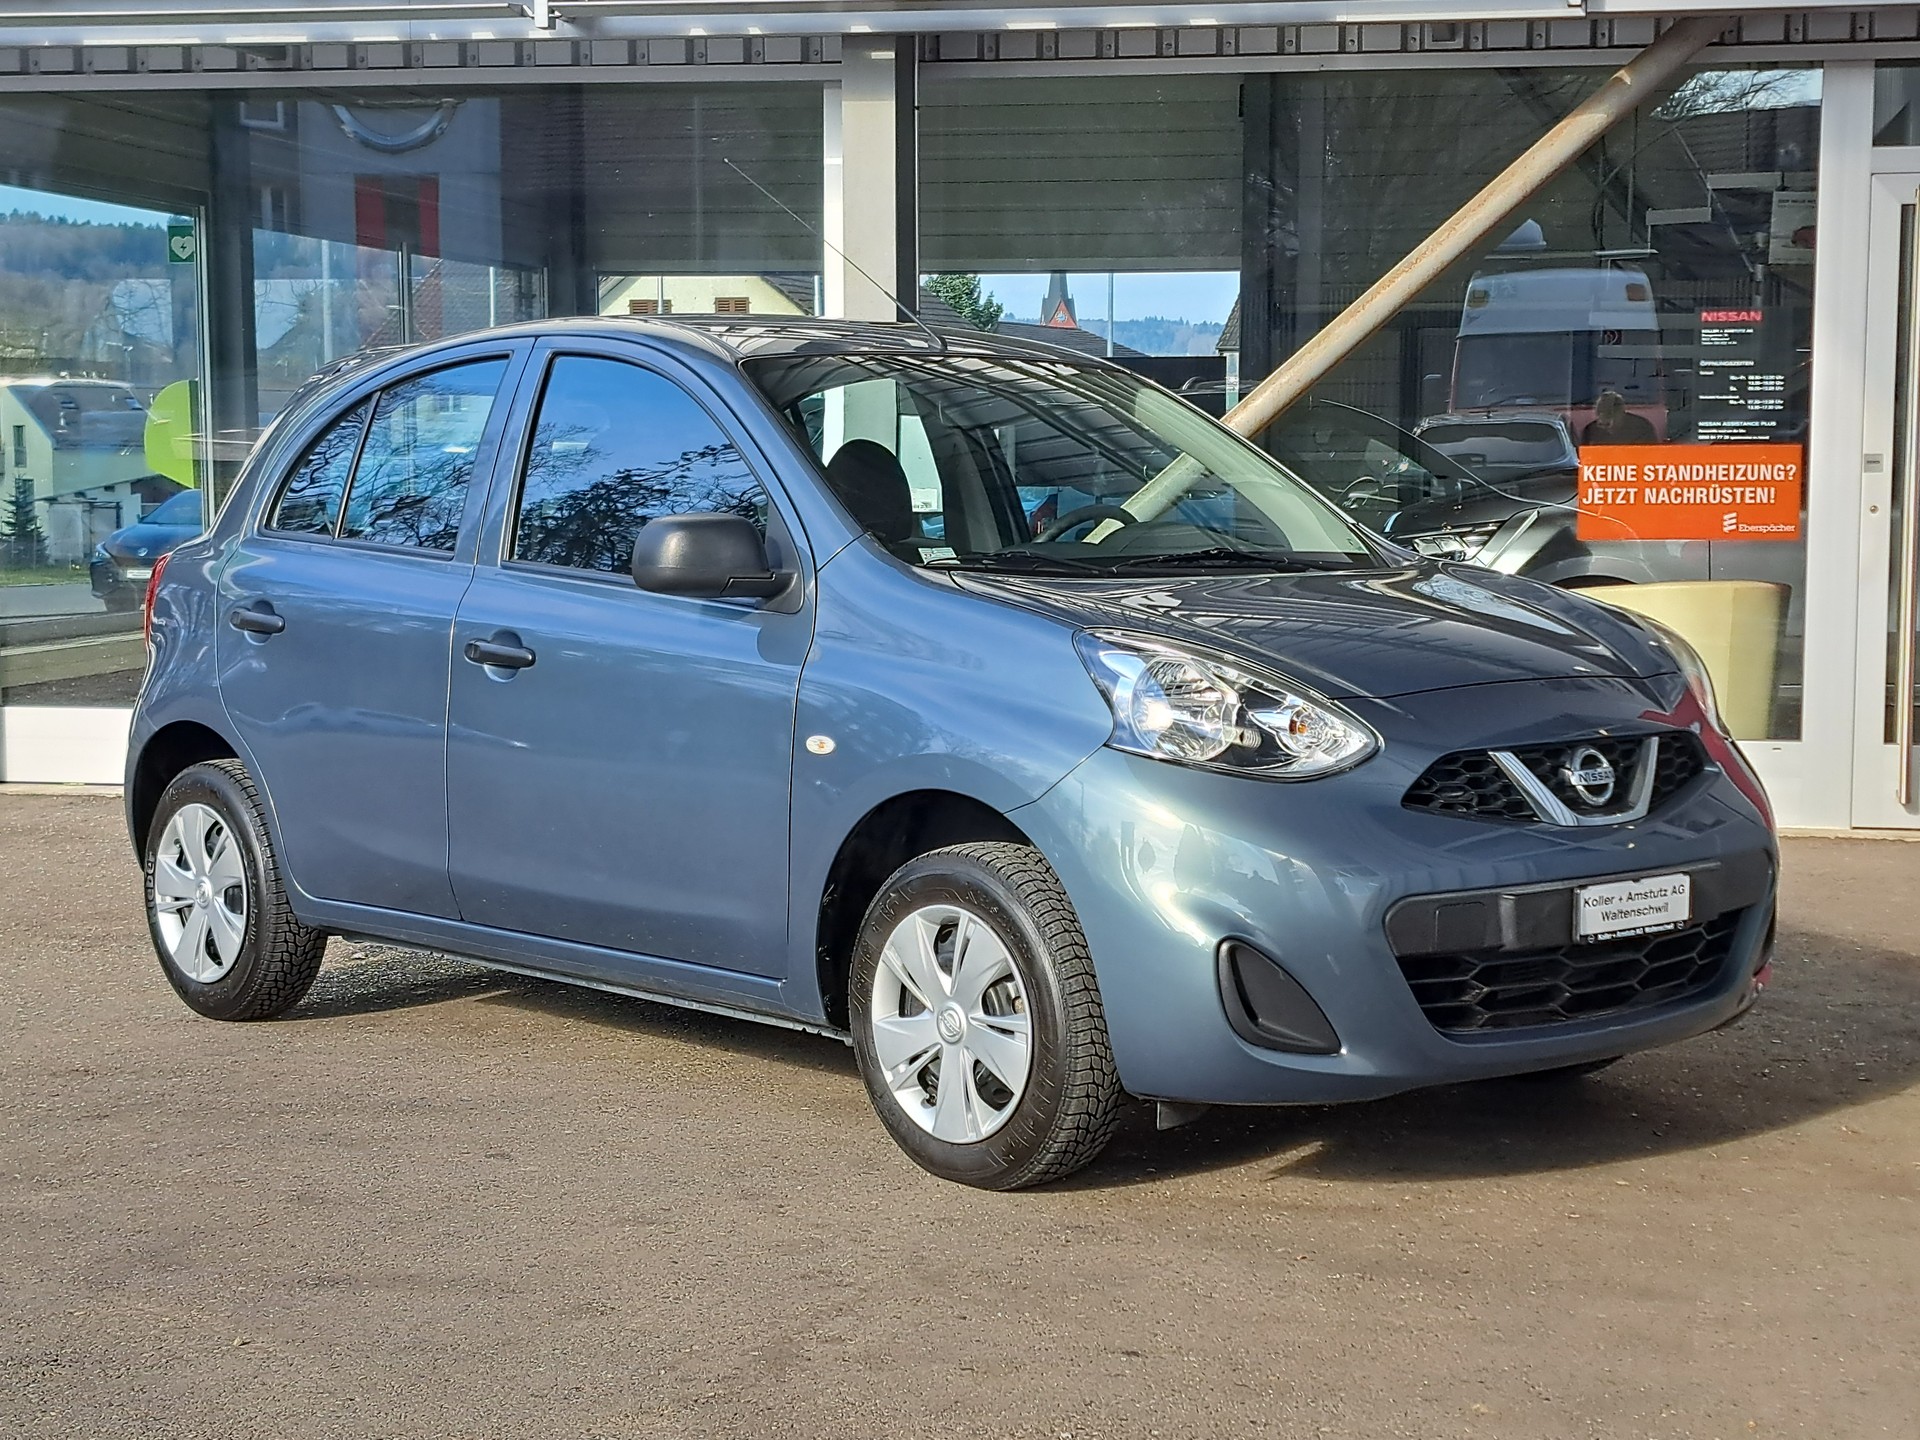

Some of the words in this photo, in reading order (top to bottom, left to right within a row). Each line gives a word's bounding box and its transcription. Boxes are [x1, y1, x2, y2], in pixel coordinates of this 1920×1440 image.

[1701, 311, 1762, 321] NISSAN
[1583, 465, 1637, 481] KEINE
[1643, 464, 1797, 481] STANDHEIZUNG?
[1583, 487, 1638, 504] JETZT
[1644, 484, 1775, 504] NACHRÜSTEN!
[1583, 896, 1615, 908] Koller
[1626, 889, 1668, 902] Amstutz
[1671, 884, 1685, 896] AG
[1601, 903, 1669, 922] Waltenschwil
